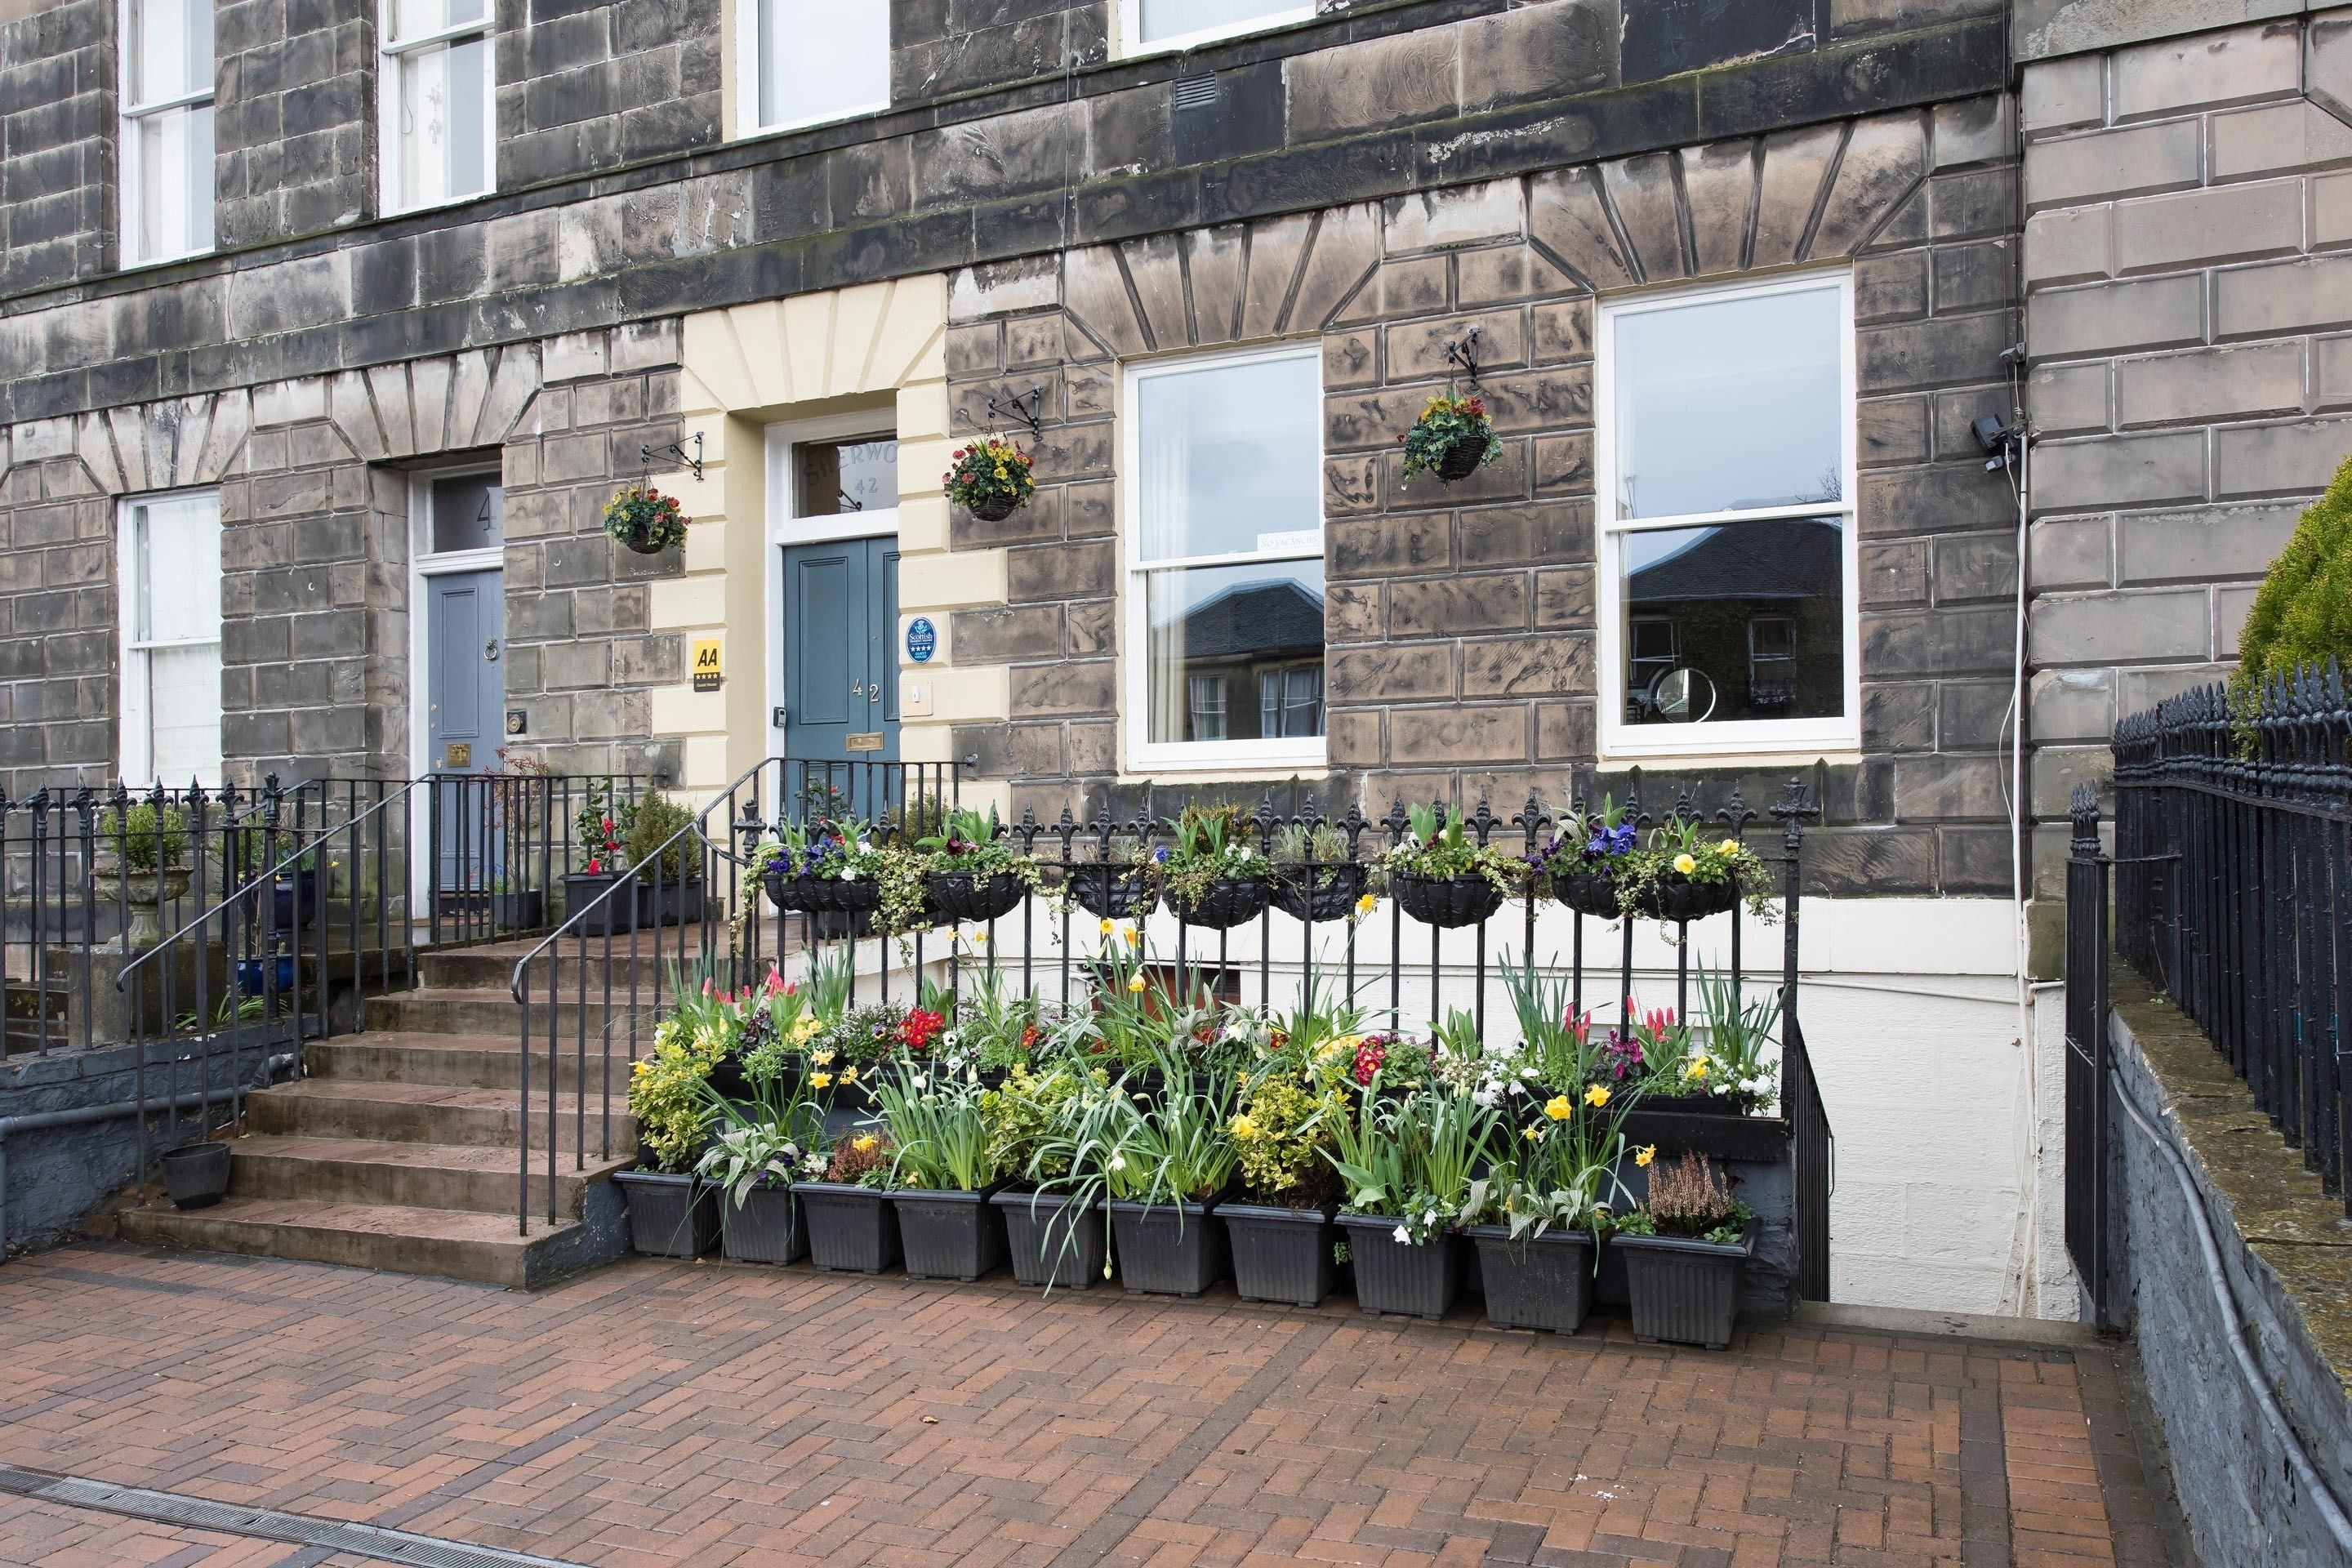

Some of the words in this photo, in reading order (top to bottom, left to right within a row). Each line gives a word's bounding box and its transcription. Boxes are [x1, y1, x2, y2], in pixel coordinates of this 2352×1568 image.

[854, 477, 878, 495] 42
[477, 493, 503, 531] 4
[697, 648, 717, 666] AA
[853, 678, 880, 702] 42
